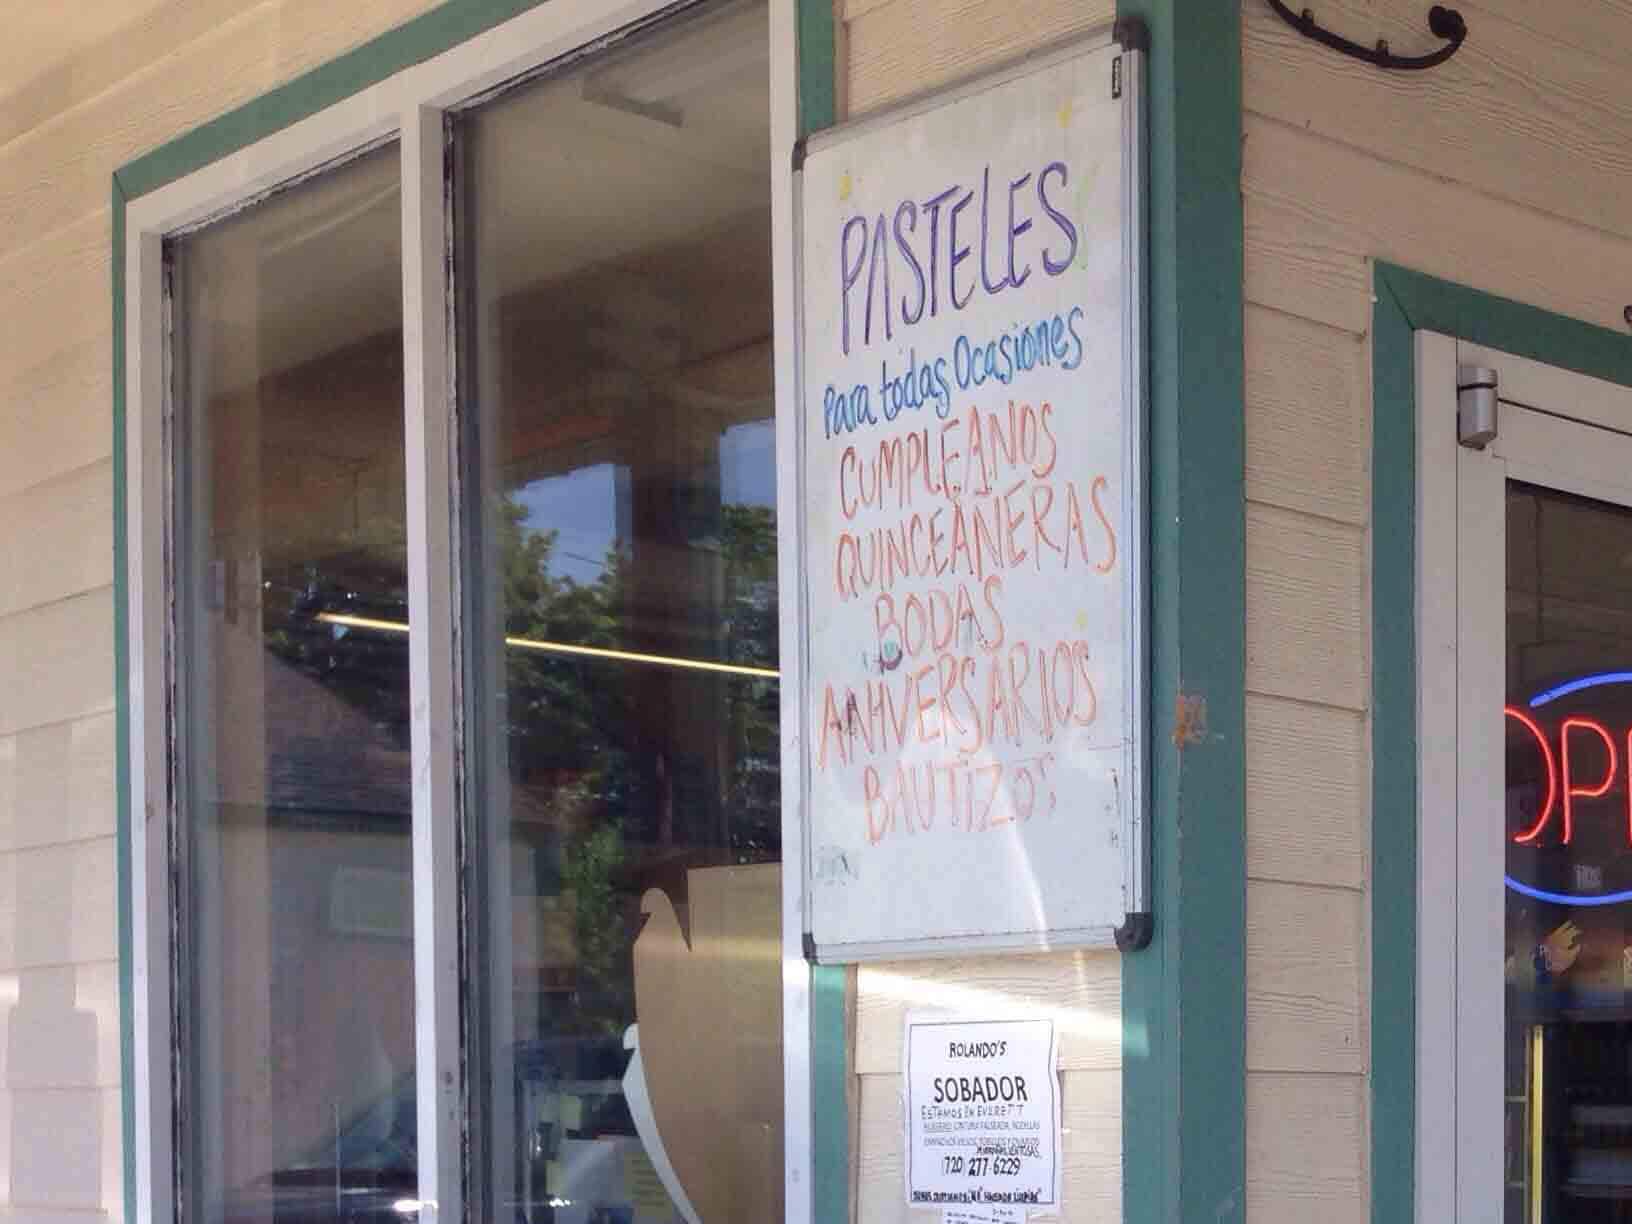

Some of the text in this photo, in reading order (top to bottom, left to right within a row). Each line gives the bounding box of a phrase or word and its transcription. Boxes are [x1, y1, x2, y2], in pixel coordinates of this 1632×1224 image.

[841, 161, 1078, 357] PASTELES
[880, 349, 952, 419] todas
[953, 306, 1084, 392] Ocasiones
[933, 1076, 1029, 1103] SOBADOR
